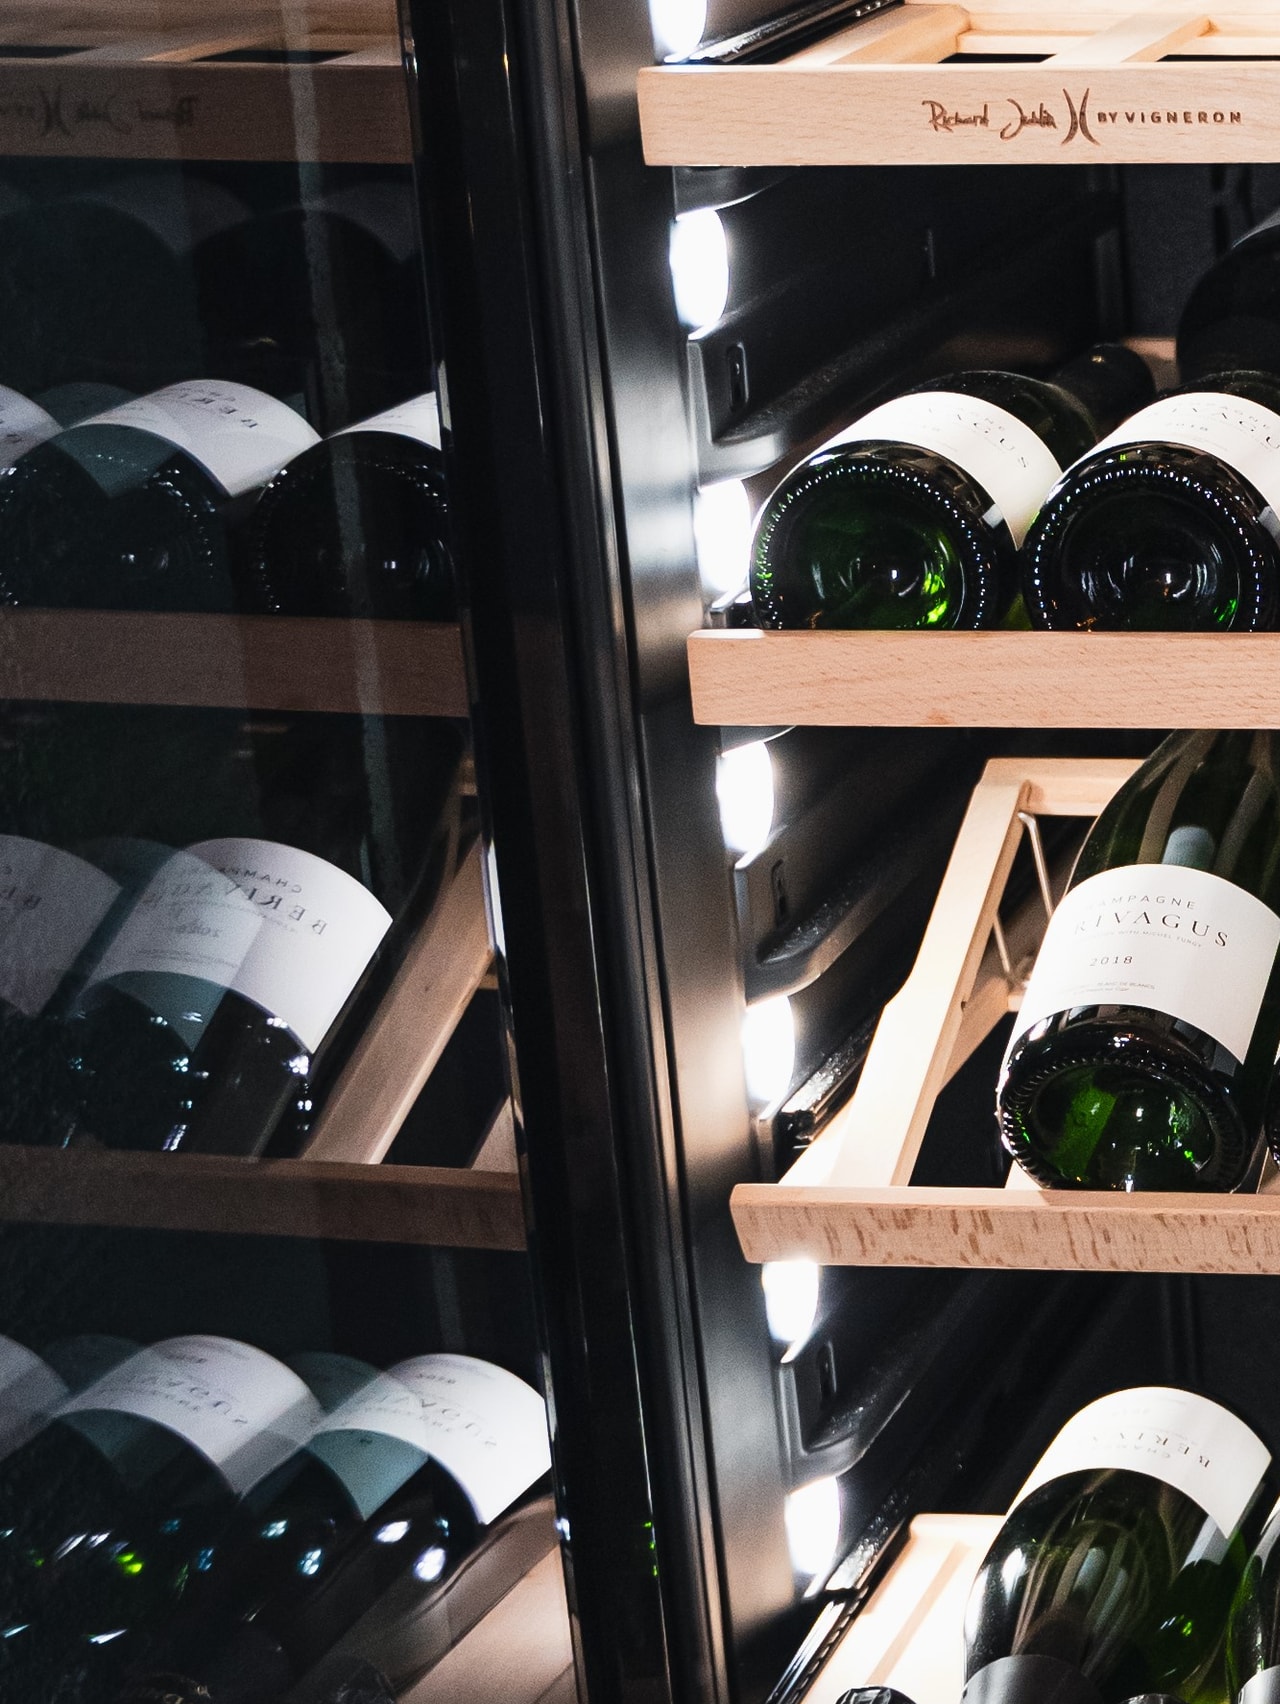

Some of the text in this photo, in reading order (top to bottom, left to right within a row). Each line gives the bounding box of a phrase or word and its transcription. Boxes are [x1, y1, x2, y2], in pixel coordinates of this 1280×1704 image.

[1097, 111, 1118, 124] BY
[1124, 111, 1243, 124] VIGNERON
[1089, 955, 1134, 967] 2018
